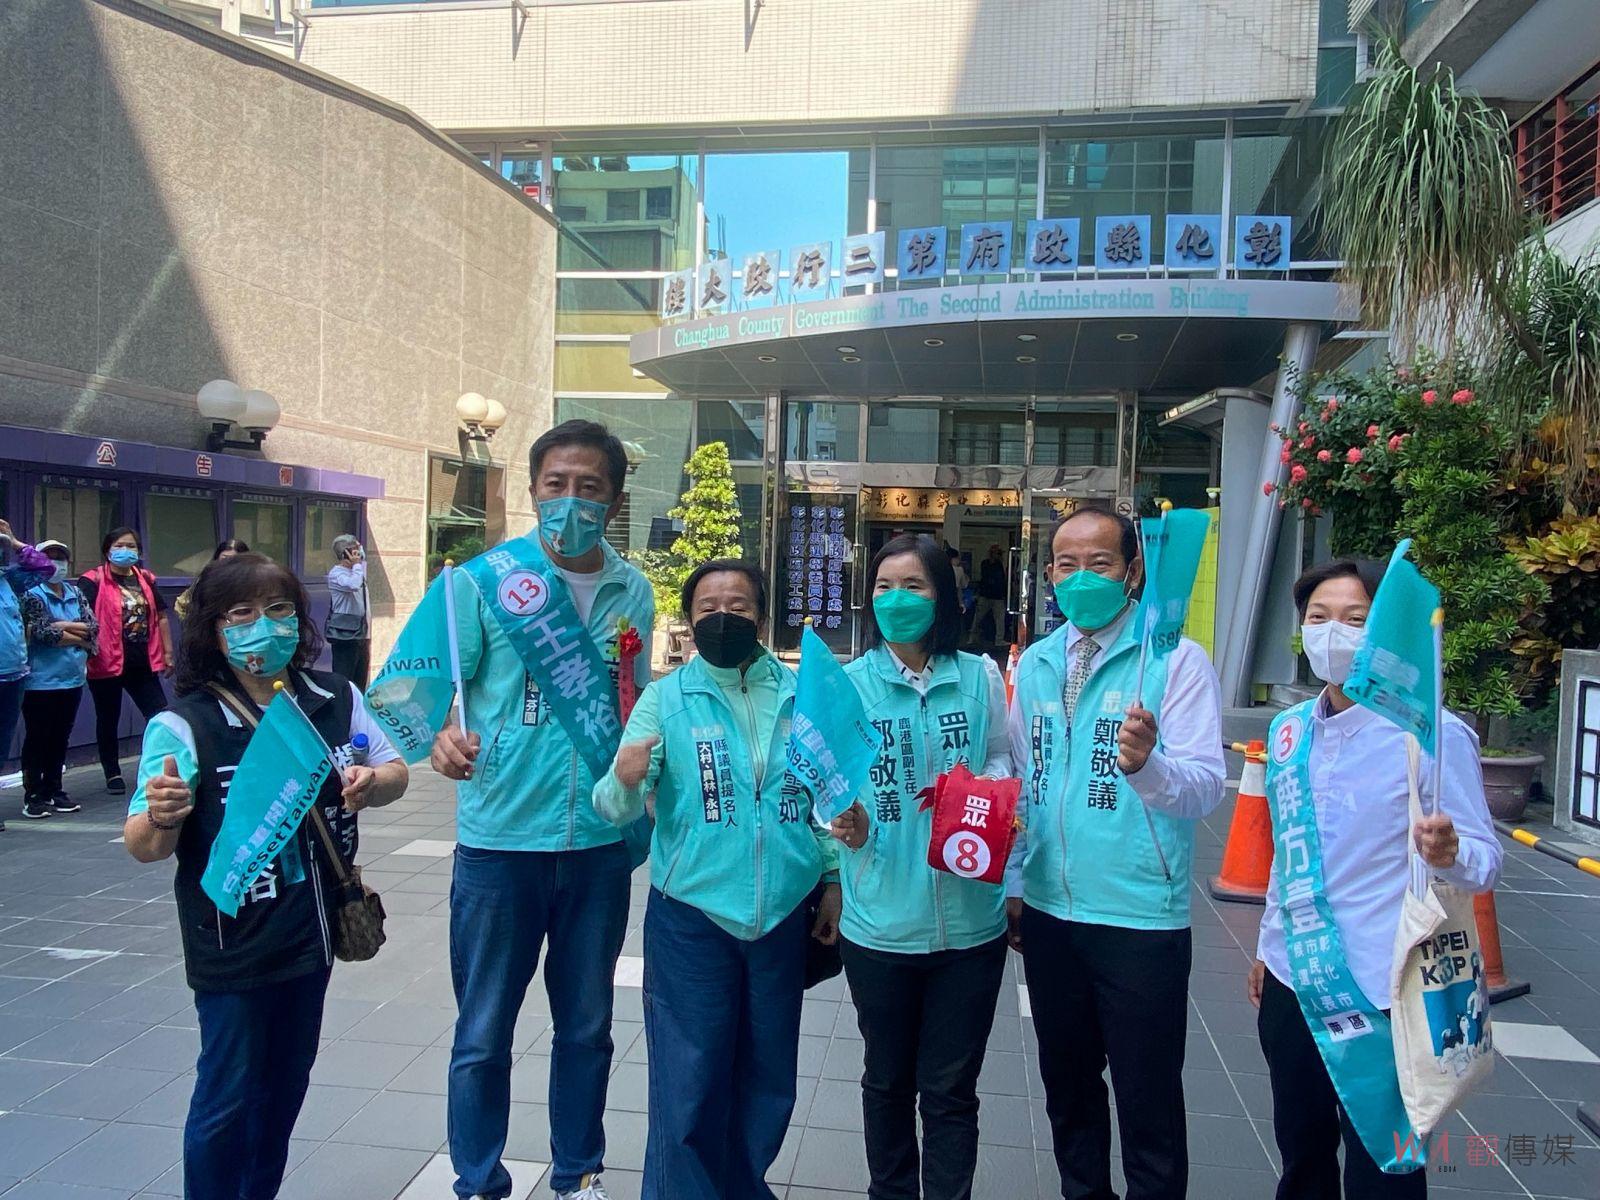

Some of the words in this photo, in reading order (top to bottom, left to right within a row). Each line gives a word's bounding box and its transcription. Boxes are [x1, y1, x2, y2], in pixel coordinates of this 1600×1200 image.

[674, 321, 730, 348] Changhua
[738, 315, 784, 338] County
[795, 300, 886, 329] Government
[897, 296, 929, 318] The
[940, 286, 1002, 315] Second
[1014, 286, 1155, 312] Administration
[1169, 286, 1249, 316] Building
[508, 577, 541, 610] 13
[937, 711, 971, 750] 眾
[1280, 724, 1293, 758] 3
[714, 738, 738, 829] 縣議員提名人
[960, 794, 992, 829] 眾
[955, 838, 979, 873] 8
